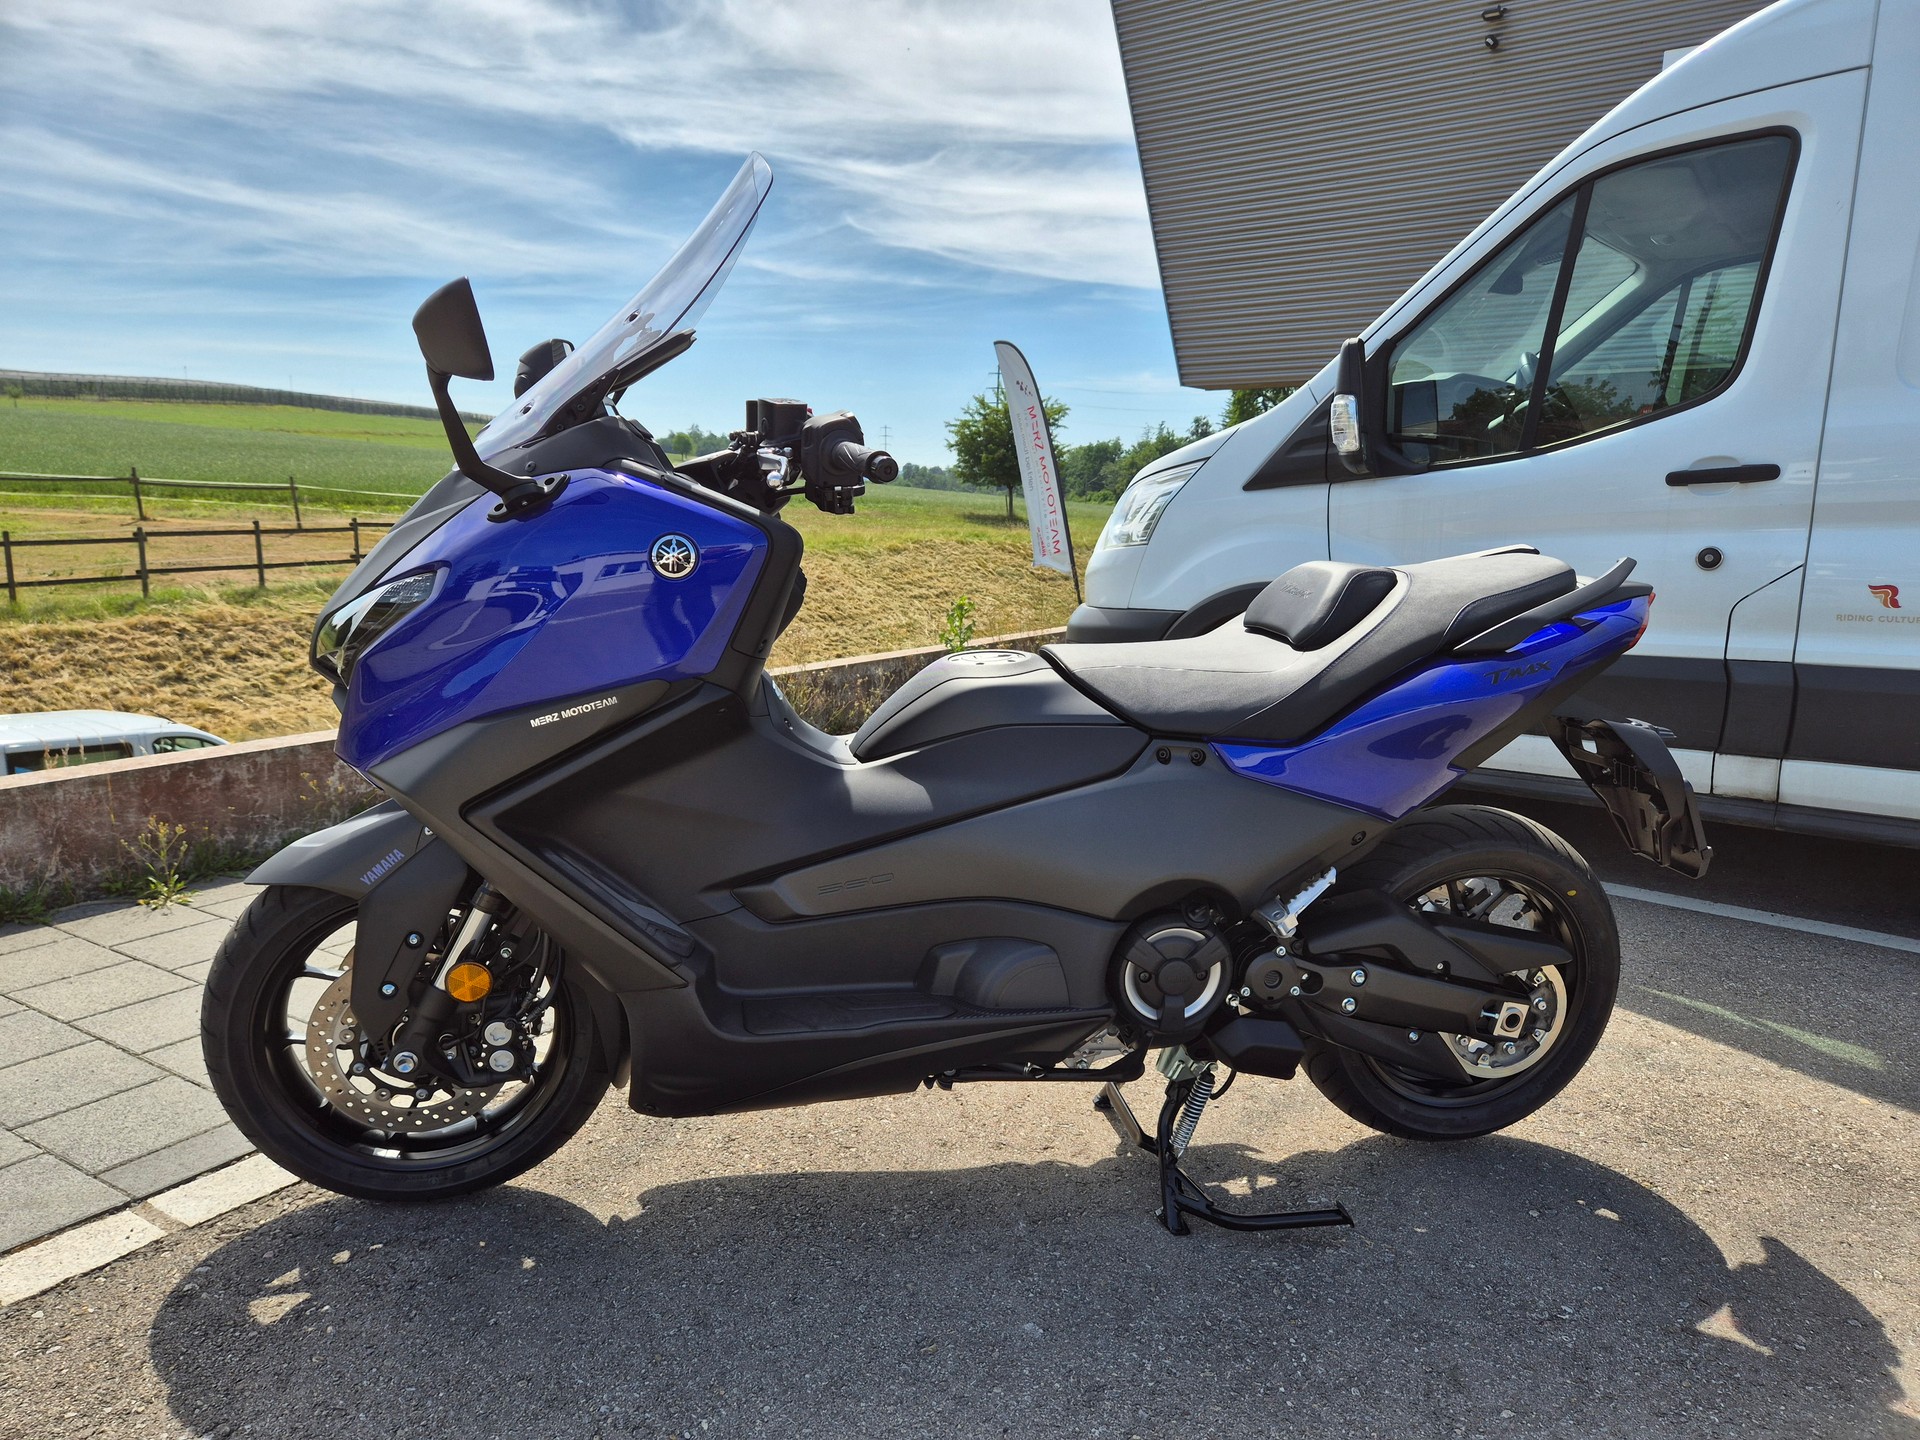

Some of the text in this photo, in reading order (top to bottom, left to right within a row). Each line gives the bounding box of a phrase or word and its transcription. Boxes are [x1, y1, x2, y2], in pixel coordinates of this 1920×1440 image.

[1027, 405, 1061, 554] MERZ MOTOTEAM
[1836, 614, 1873, 622] RIDING
[529, 696, 618, 728] MERZ MOTOTEAM
[360, 848, 405, 885] YAMAHA
